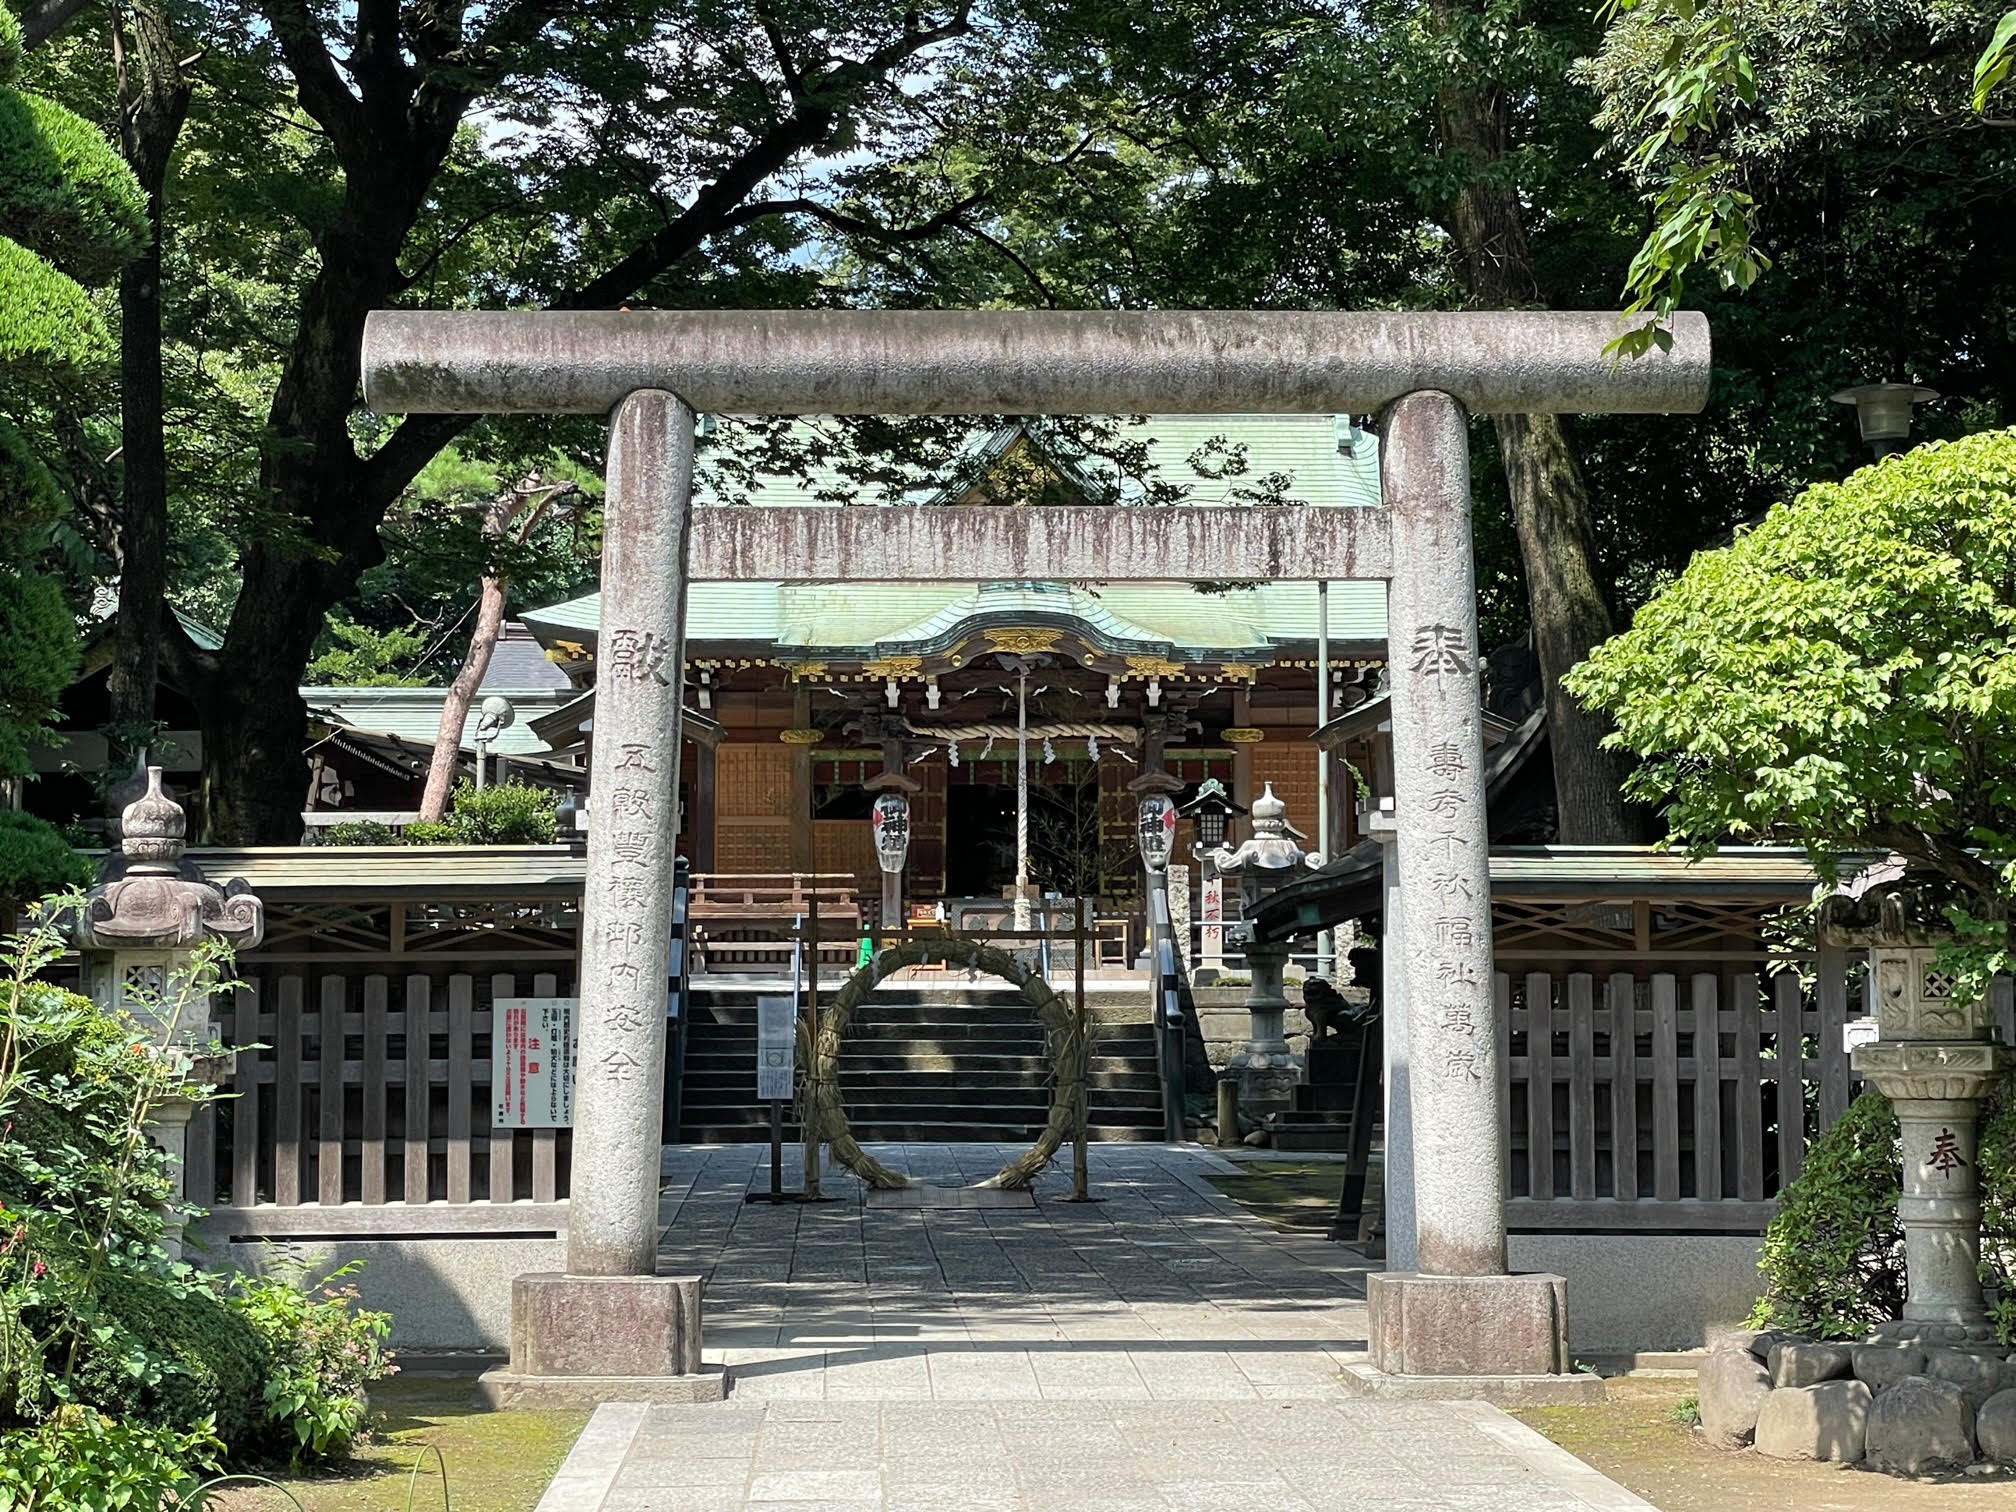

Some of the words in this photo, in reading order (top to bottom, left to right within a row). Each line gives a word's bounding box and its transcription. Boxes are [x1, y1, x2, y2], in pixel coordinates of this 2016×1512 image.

[1205, 873, 1220, 939] 千秋不朽
[1926, 1128, 1968, 1180] 奉
